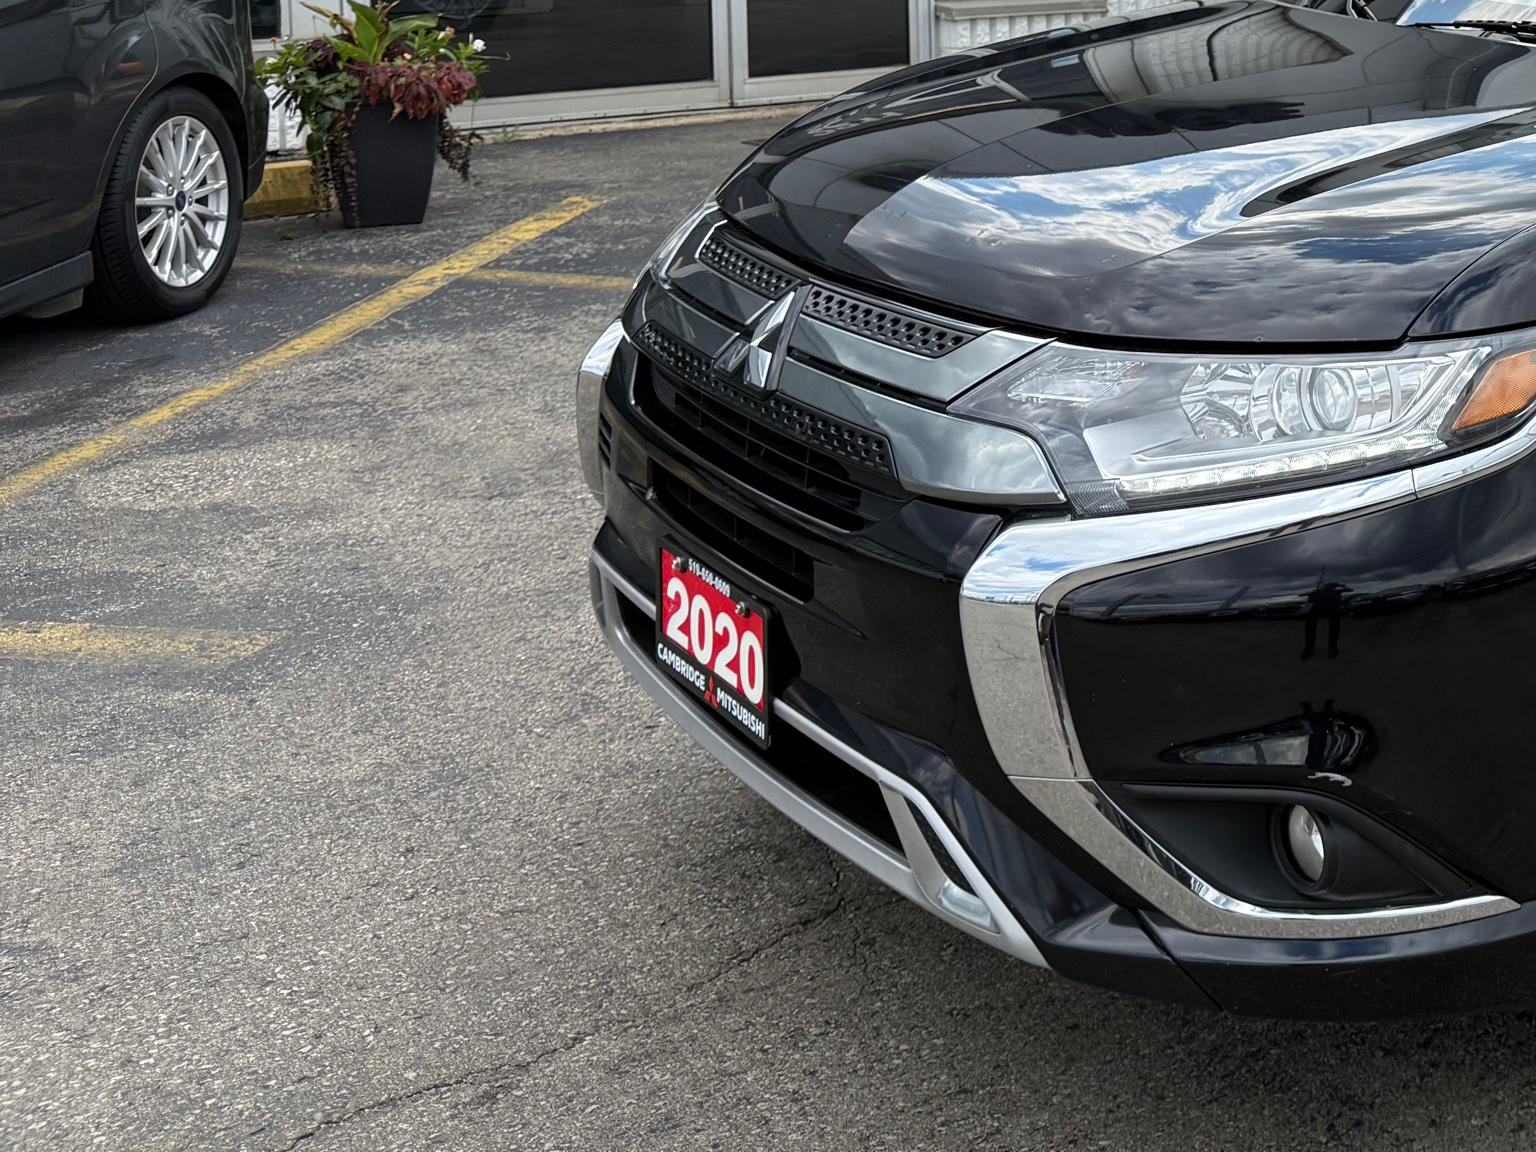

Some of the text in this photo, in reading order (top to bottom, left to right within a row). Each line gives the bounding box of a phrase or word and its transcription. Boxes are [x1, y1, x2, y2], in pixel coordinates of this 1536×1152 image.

[657, 643, 765, 740] CAMBRIDGE MITSUBISHI
[666, 577, 764, 705] 2020
